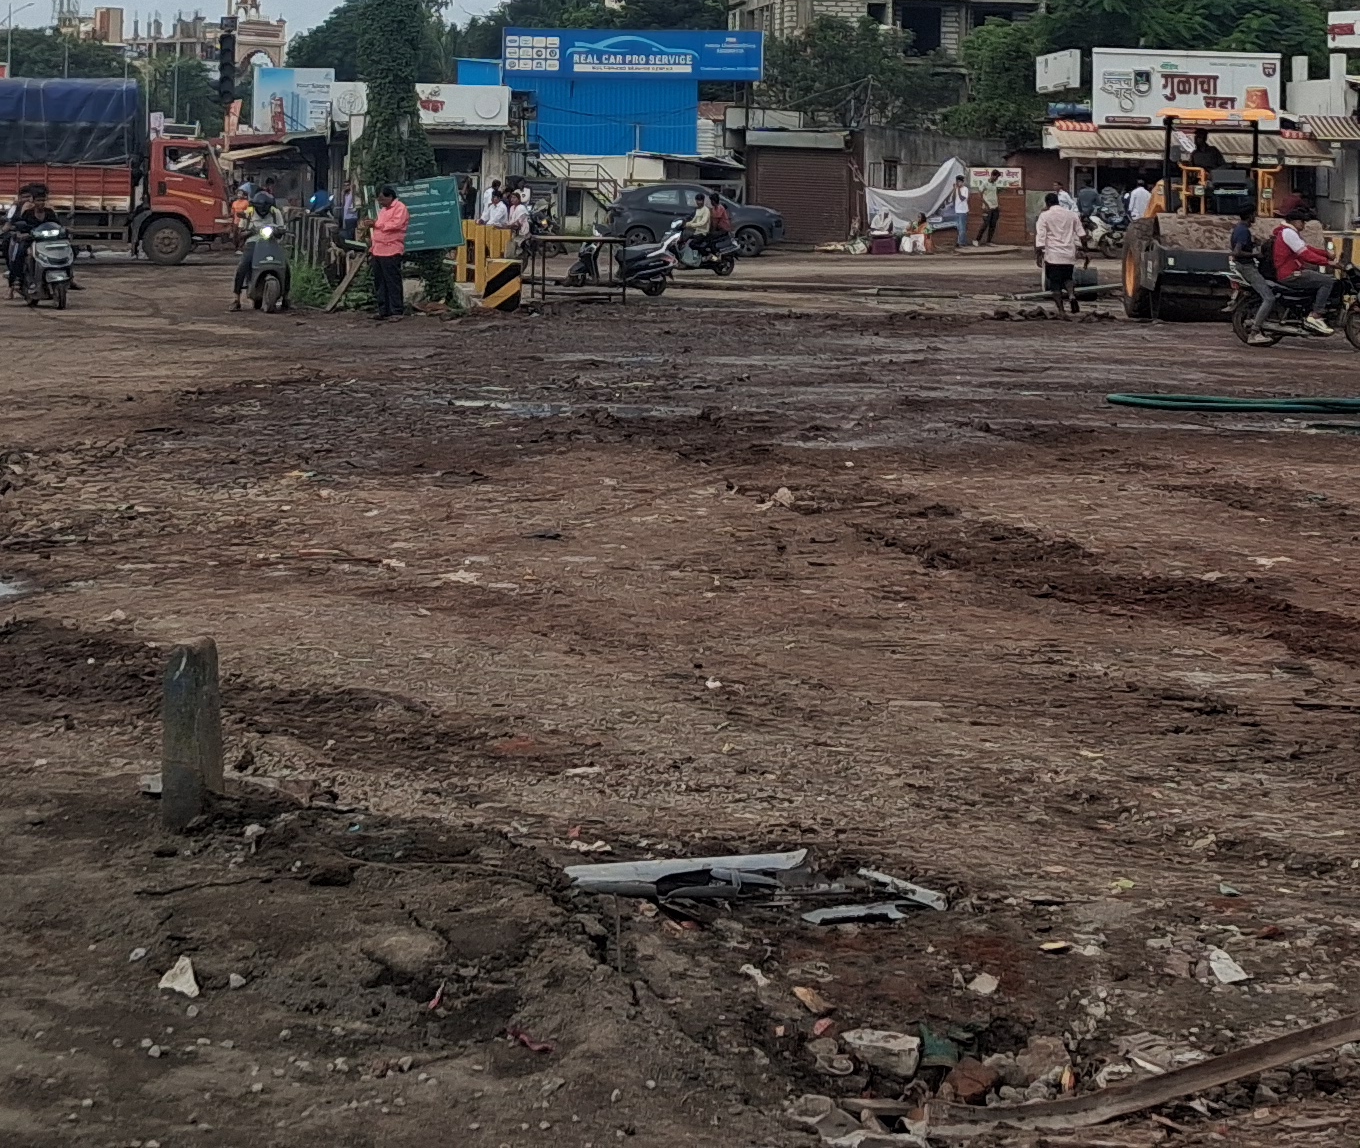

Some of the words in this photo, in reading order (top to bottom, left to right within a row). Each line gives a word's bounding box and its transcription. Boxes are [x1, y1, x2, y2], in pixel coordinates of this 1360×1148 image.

[573, 53, 599, 64] REAL
[602, 54, 622, 64] CAR
[625, 54, 646, 64] PRO
[649, 54, 693, 65] SERVICE
[1161, 73, 1219, 102] गुळाचा
